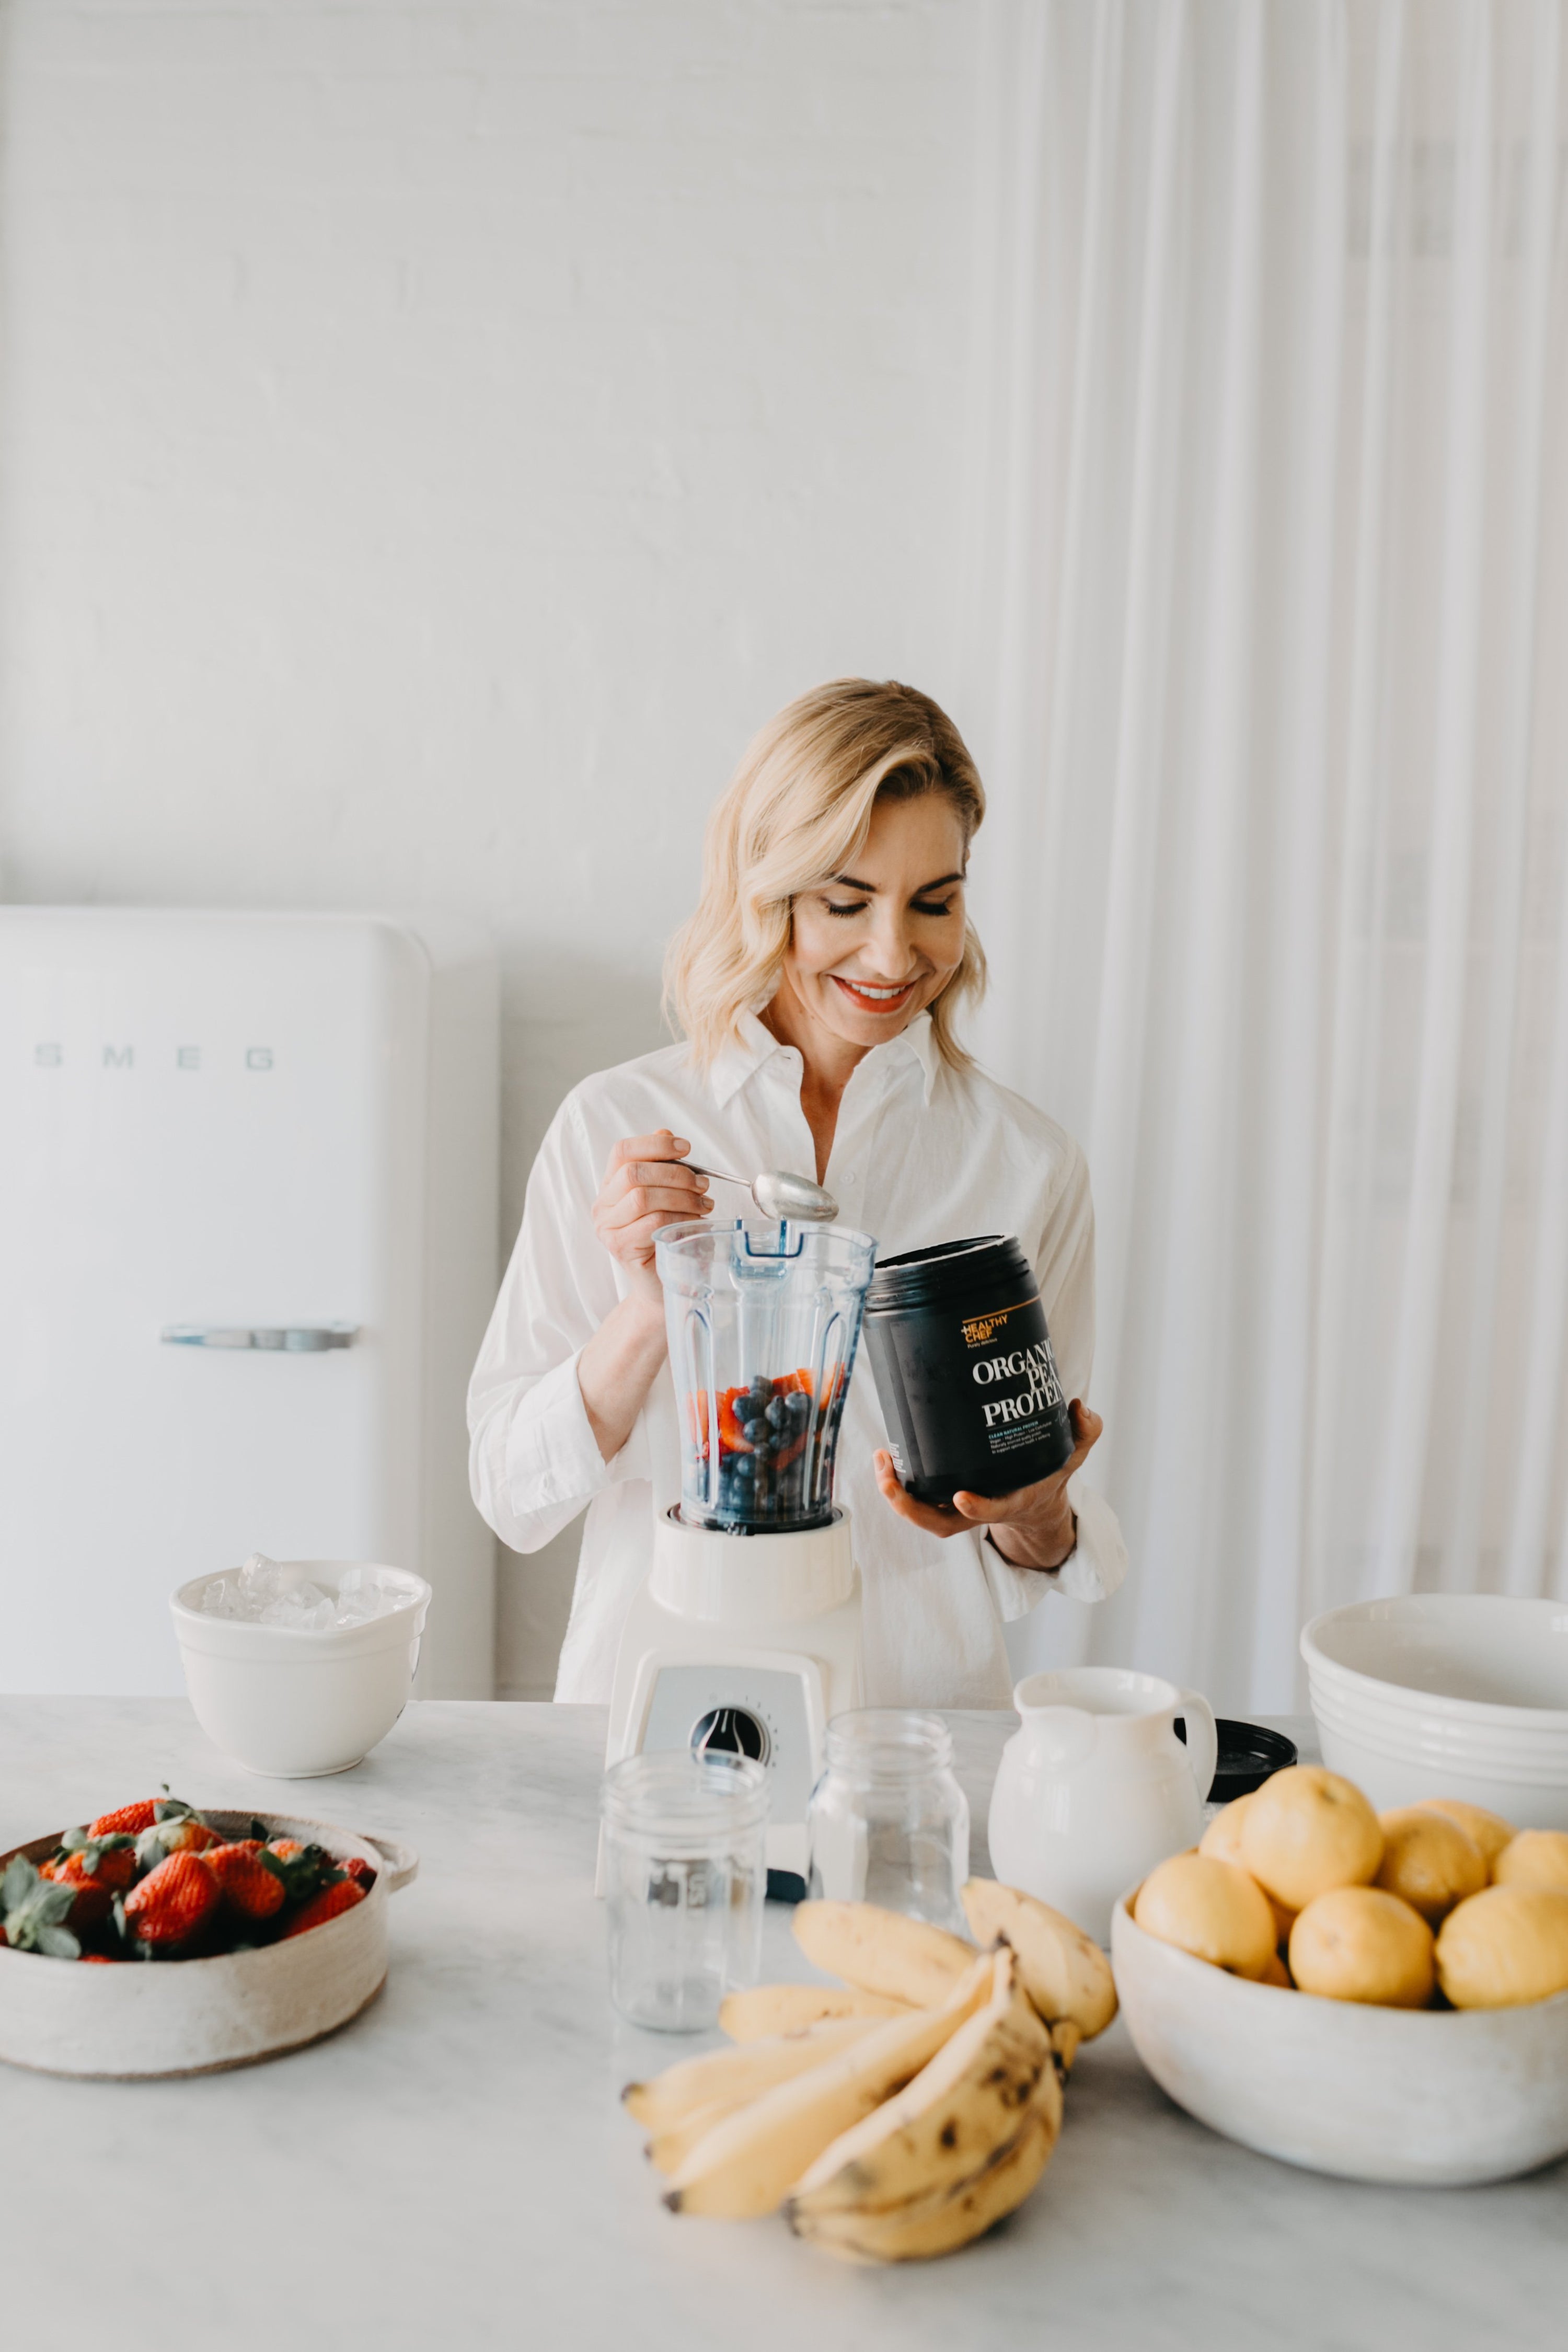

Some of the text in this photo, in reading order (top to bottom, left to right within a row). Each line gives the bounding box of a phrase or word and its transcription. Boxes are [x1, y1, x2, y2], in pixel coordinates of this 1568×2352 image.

[34, 1043, 273, 1070] SMEG
[965, 1325, 992, 1343] CHEF
[1027, 1361, 1057, 1391] PEA
[982, 1380, 1064, 1427] PROTEIN
[1004, 1426, 1022, 1436] NATURAL
[1022, 1420, 1039, 1430] PROTEIN
